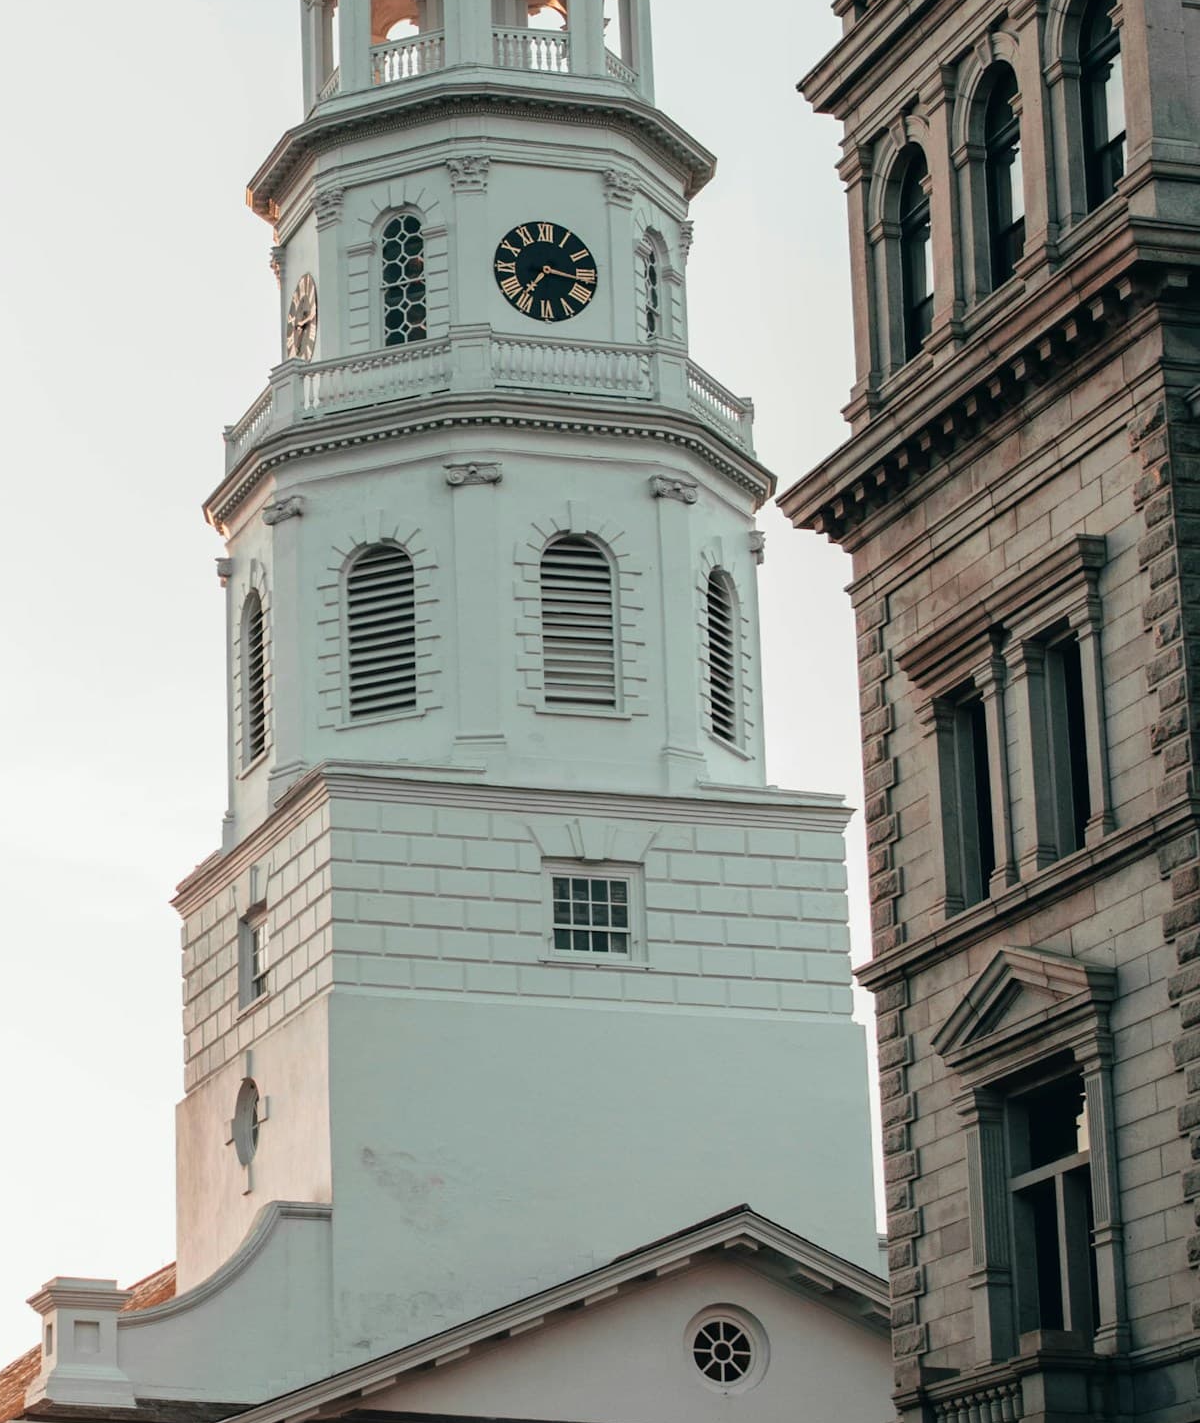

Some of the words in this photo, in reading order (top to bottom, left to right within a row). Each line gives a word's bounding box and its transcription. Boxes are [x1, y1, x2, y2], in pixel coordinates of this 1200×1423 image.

[516, 226, 535, 246] XI
[537, 223, 555, 243] XII
[558, 231, 571, 248] I
[501, 240, 521, 257] X
[569, 249, 590, 263] II
[496, 260, 516, 273] IX
[500, 275, 523, 300] VIII
[516, 292, 534, 313] VII
[540, 300, 554, 319] VI
[560, 298, 575, 316] V
